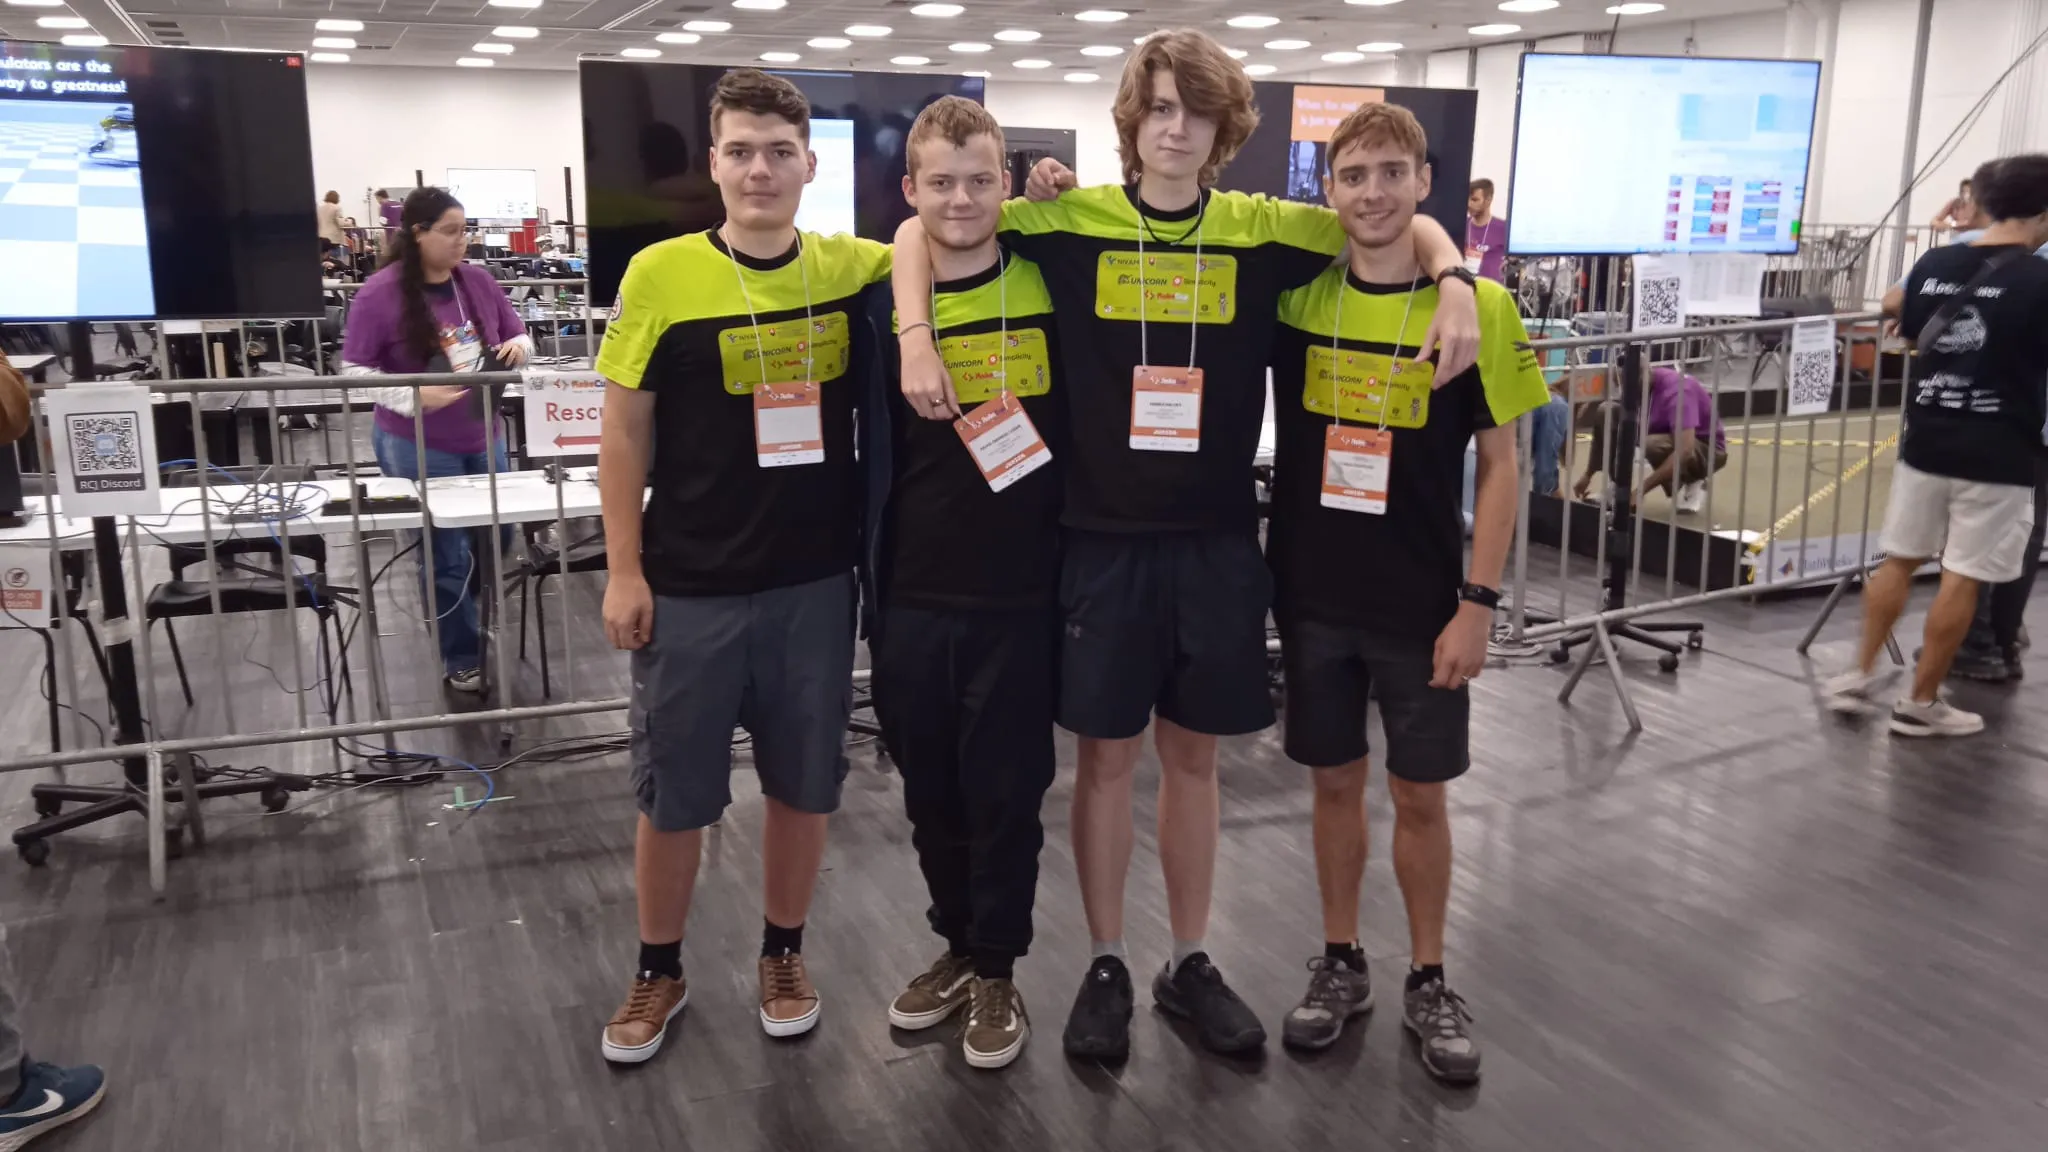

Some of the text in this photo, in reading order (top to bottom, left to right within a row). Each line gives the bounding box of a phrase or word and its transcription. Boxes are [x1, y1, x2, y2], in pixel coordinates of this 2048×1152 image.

[56, 62, 81, 71] are
[85, 60, 111, 73] the
[30, 79, 47, 90] to
[52, 80, 127, 94] greatness!
[947, 359, 983, 369] UNICORN
[80, 478, 141, 490] RCJ Discord
